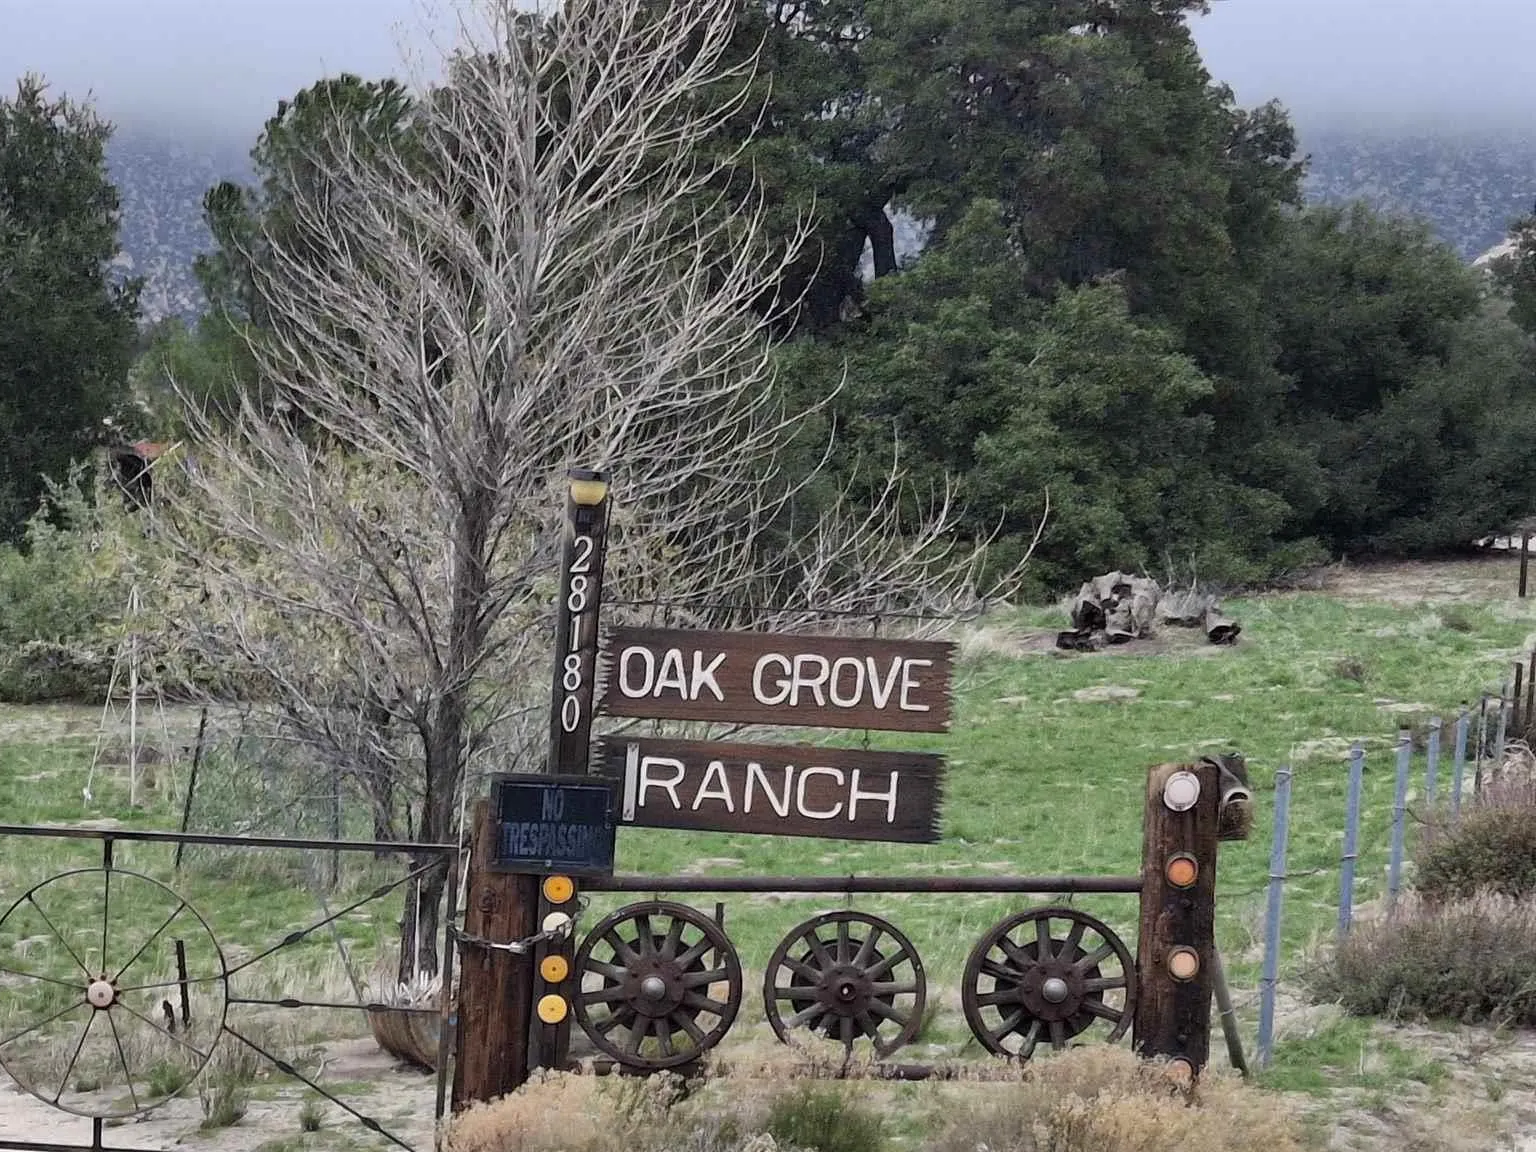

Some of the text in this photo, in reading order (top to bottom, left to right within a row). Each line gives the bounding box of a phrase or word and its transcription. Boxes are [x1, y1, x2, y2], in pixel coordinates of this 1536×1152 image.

[560, 535, 594, 733] 28180
[619, 646, 933, 711] OAK GROVE
[542, 788, 565, 820] NO
[638, 756, 899, 823] RANCH
